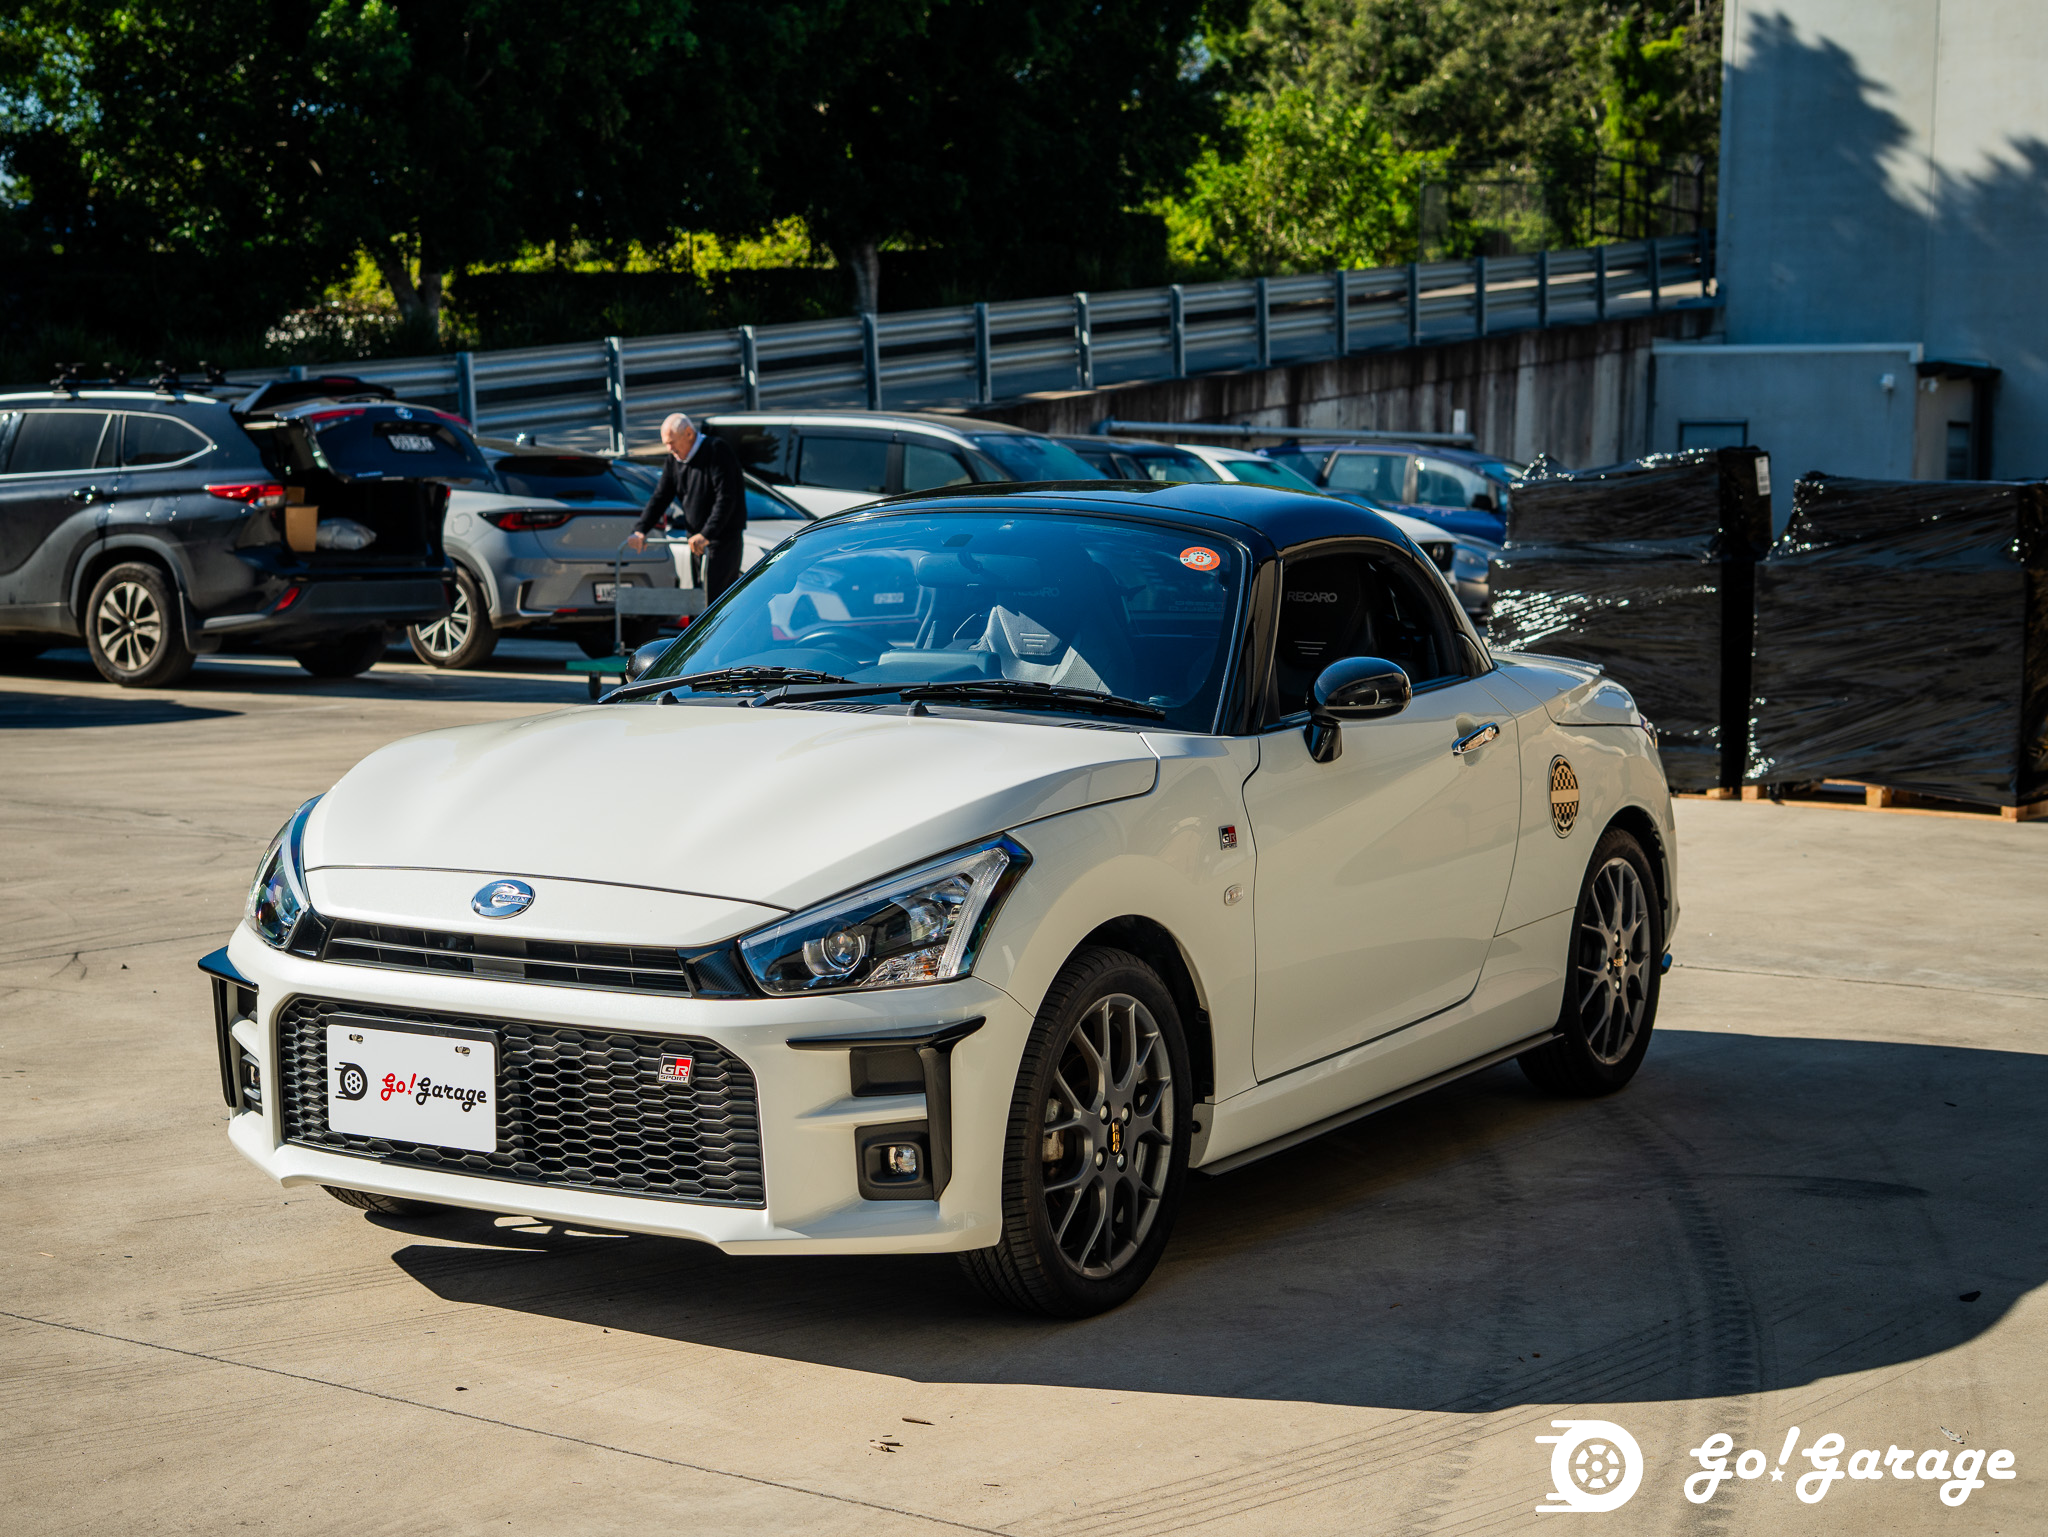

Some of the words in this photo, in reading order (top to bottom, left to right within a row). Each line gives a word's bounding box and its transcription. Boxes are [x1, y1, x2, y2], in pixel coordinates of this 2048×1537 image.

[1287, 591, 1338, 603] RECARO
[1222, 832, 1237, 843] GR
[661, 1064, 689, 1076] GR
